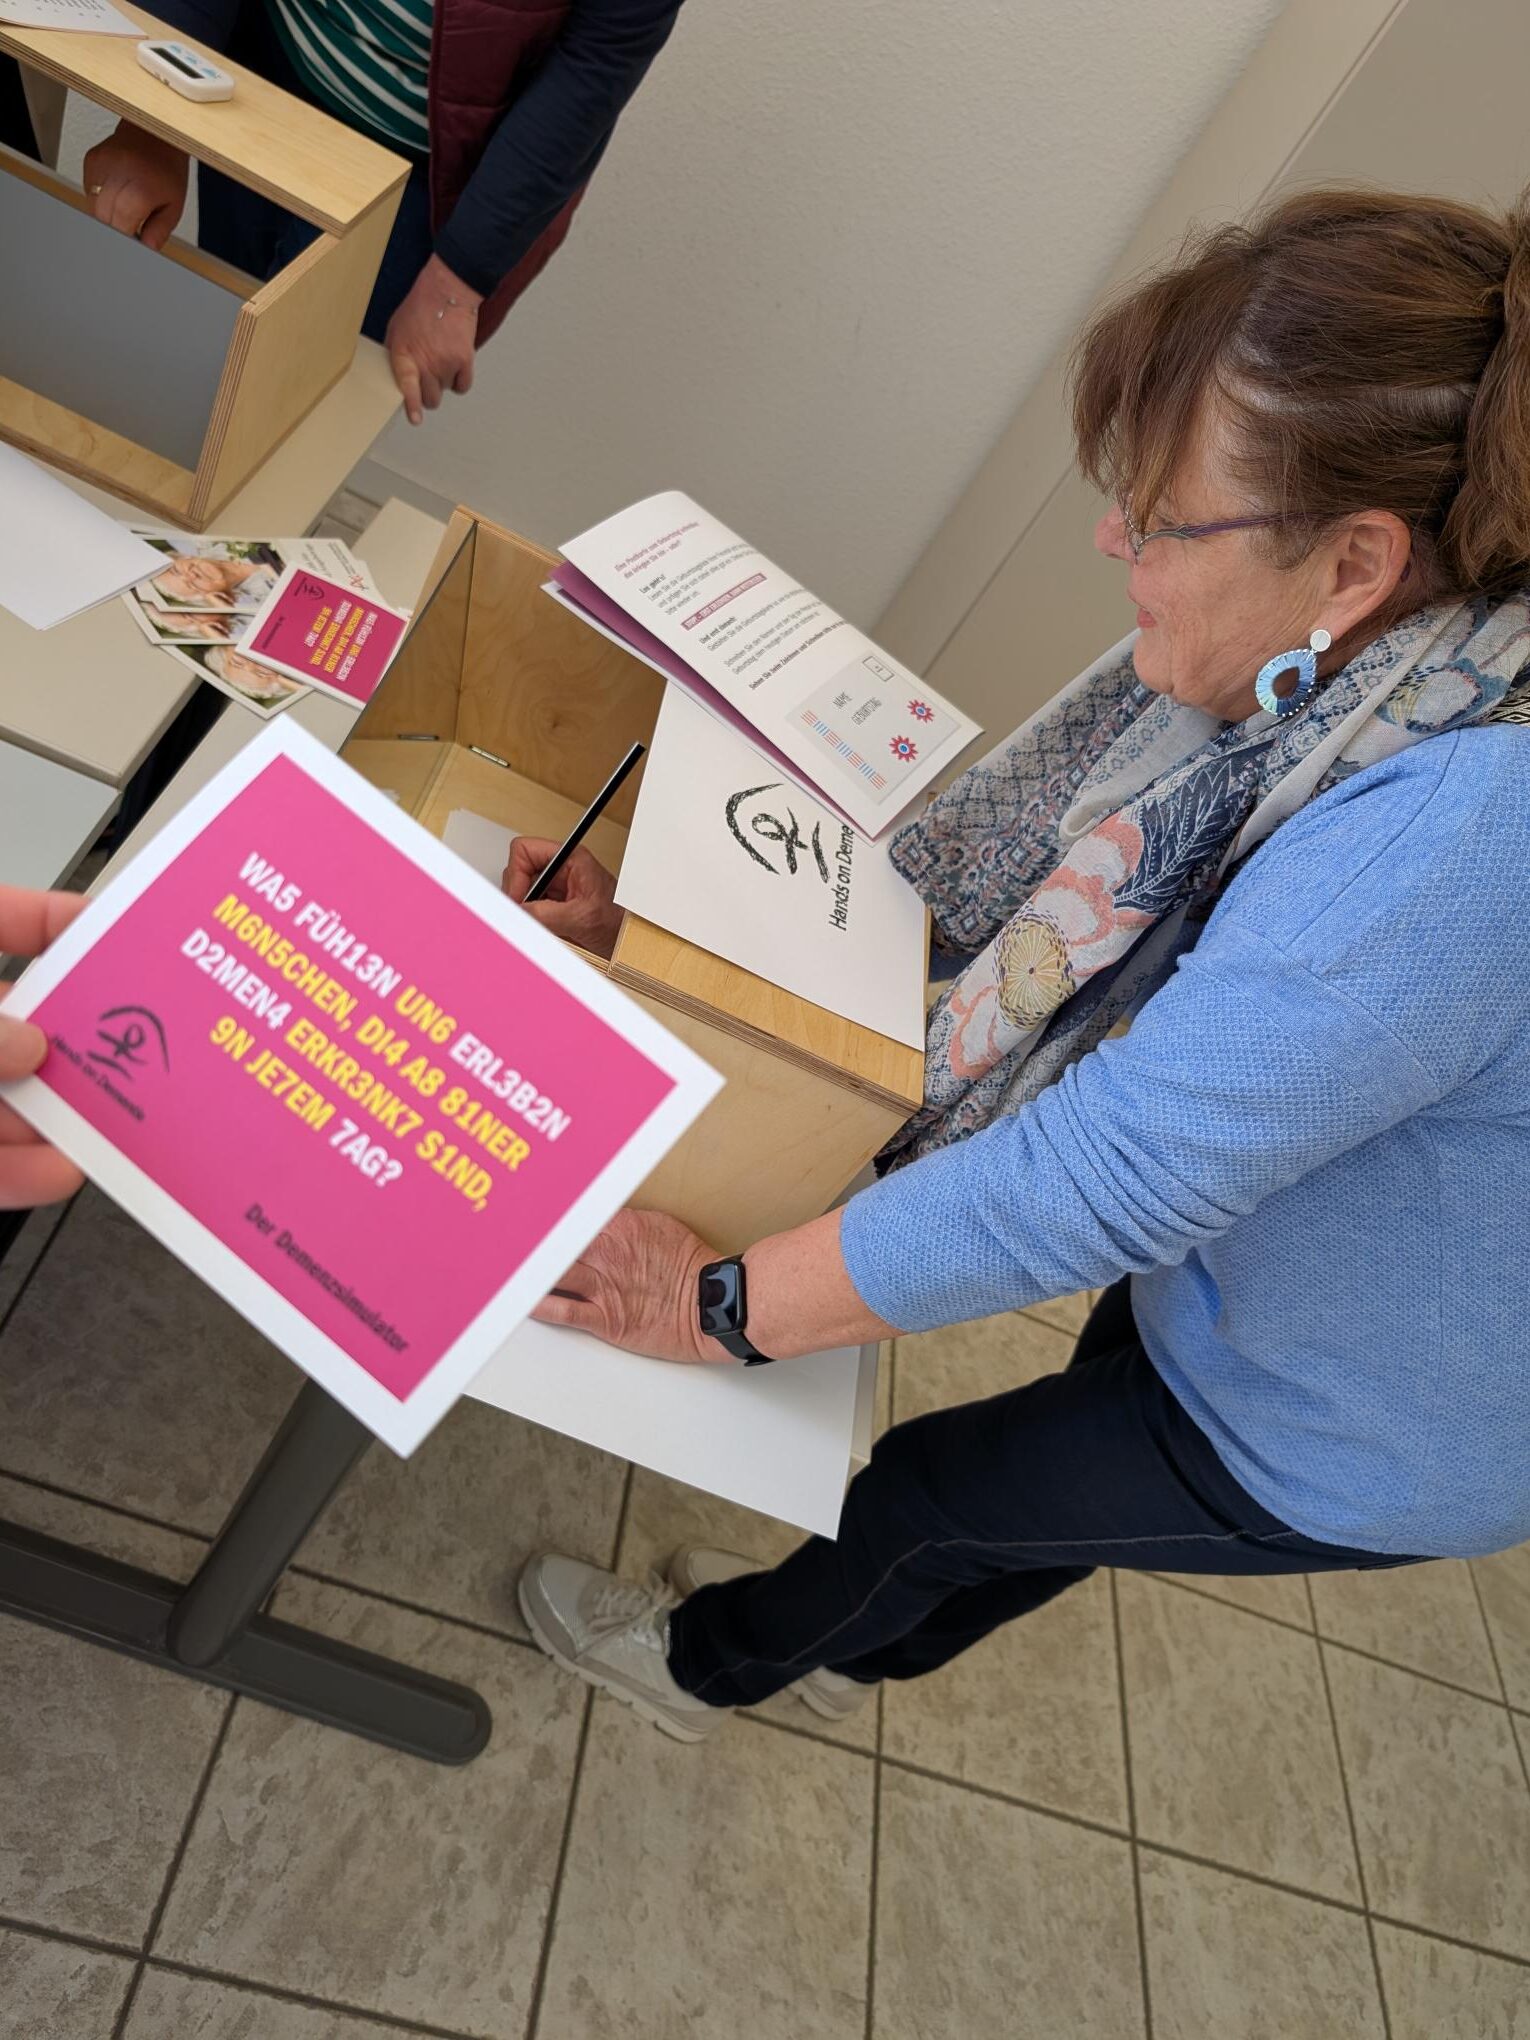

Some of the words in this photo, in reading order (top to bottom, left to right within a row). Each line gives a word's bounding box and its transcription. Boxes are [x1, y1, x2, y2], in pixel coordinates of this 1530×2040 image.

[828, 884, 850, 931] Hands
[835, 825, 854, 865] Deme
[837, 865, 851, 884] on
[181, 927, 292, 1030] D2MEN4
[284, 1017, 424, 1138] ERKR3NK7
[415, 1130, 493, 1212] S1ND,
[212, 893, 358, 1032] M6N5CHEN,
[355, 1014, 411, 1067] DI4
[399, 1055, 446, 1097] A8
[438, 1086, 531, 1172] 81NER
[239, 852, 302, 912] WA5
[293, 900, 403, 998] FÜH13N
[394, 985, 458, 1044] UN6
[449, 1031, 572, 1141] ERL3B2N
[209, 1015, 255, 1061] 9N
[244, 1050, 336, 1132] JE7EM
[330, 1117, 403, 1187] 7AG?
[246, 1203, 276, 1235] Der
[275, 1230, 409, 1353] Demenzsimulator
